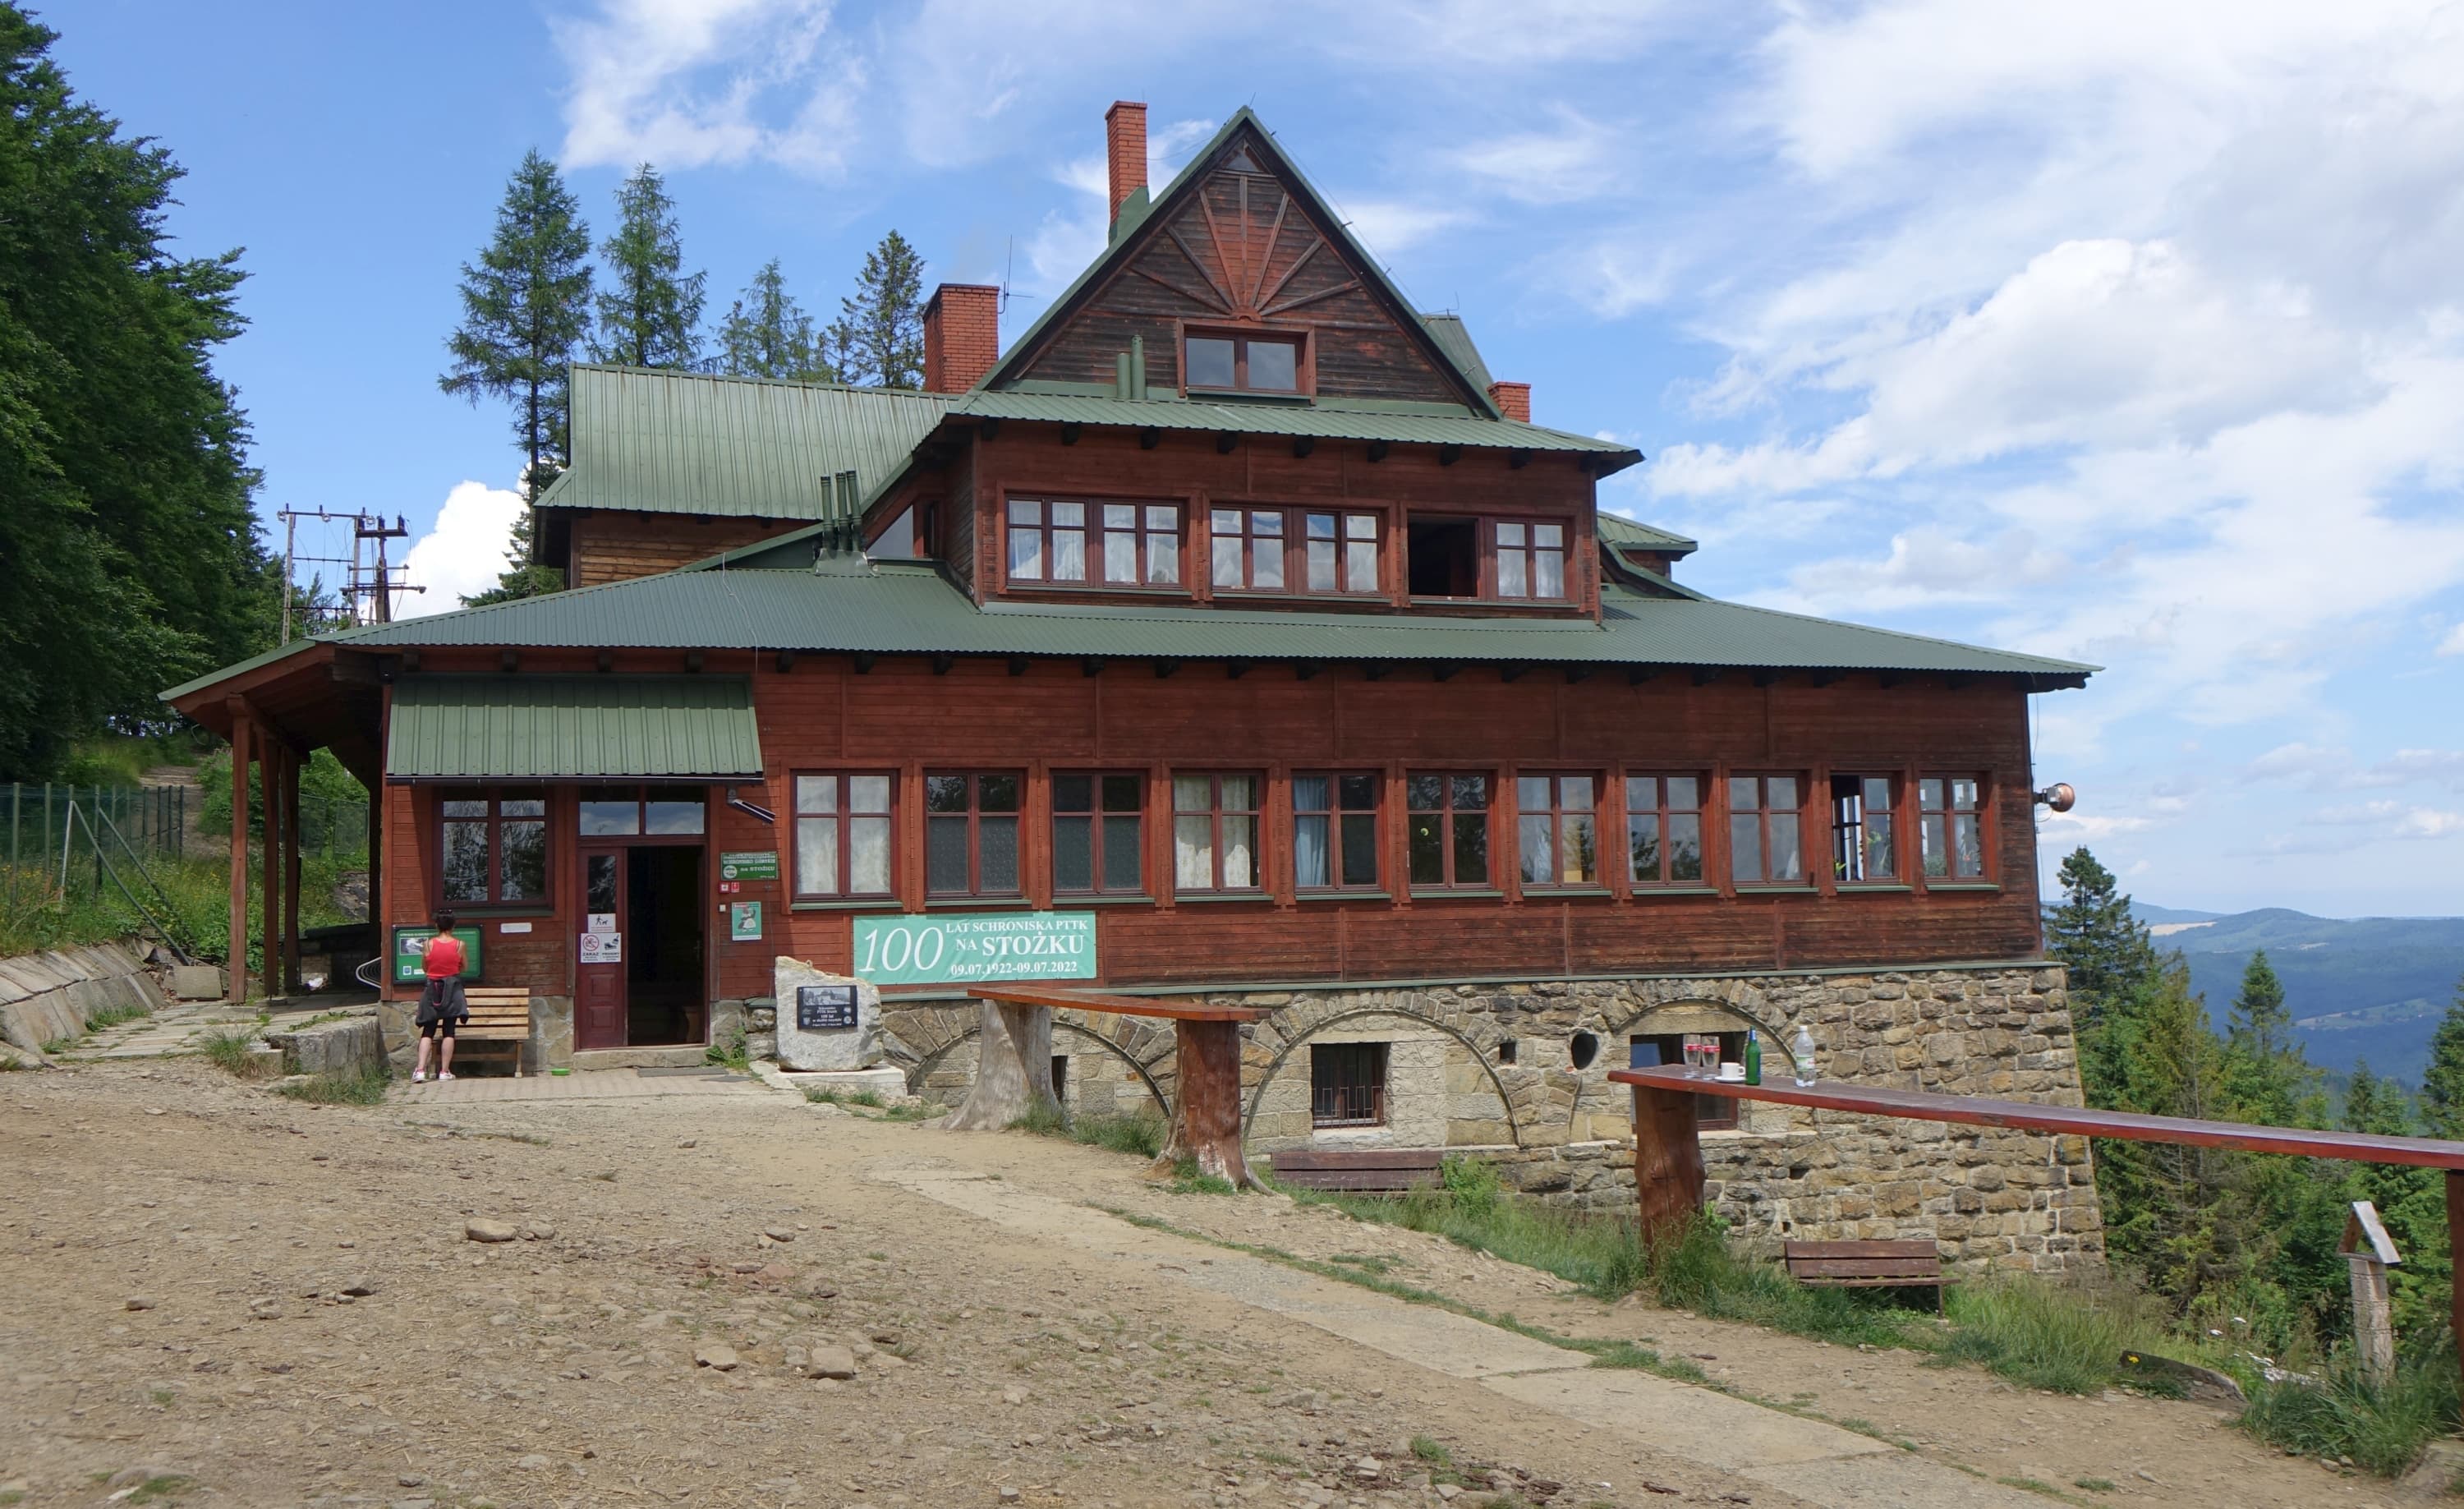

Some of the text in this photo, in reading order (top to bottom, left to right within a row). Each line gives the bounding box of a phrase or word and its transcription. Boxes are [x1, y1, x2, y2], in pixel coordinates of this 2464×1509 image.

[946, 920, 1088, 933] LAT SCHRONISKA PTTK
[858, 927, 944, 972] 100
[956, 931, 1085, 956] NA STOŻKU
[951, 961, 1078, 975] 09.07.1922-09.07.2022
